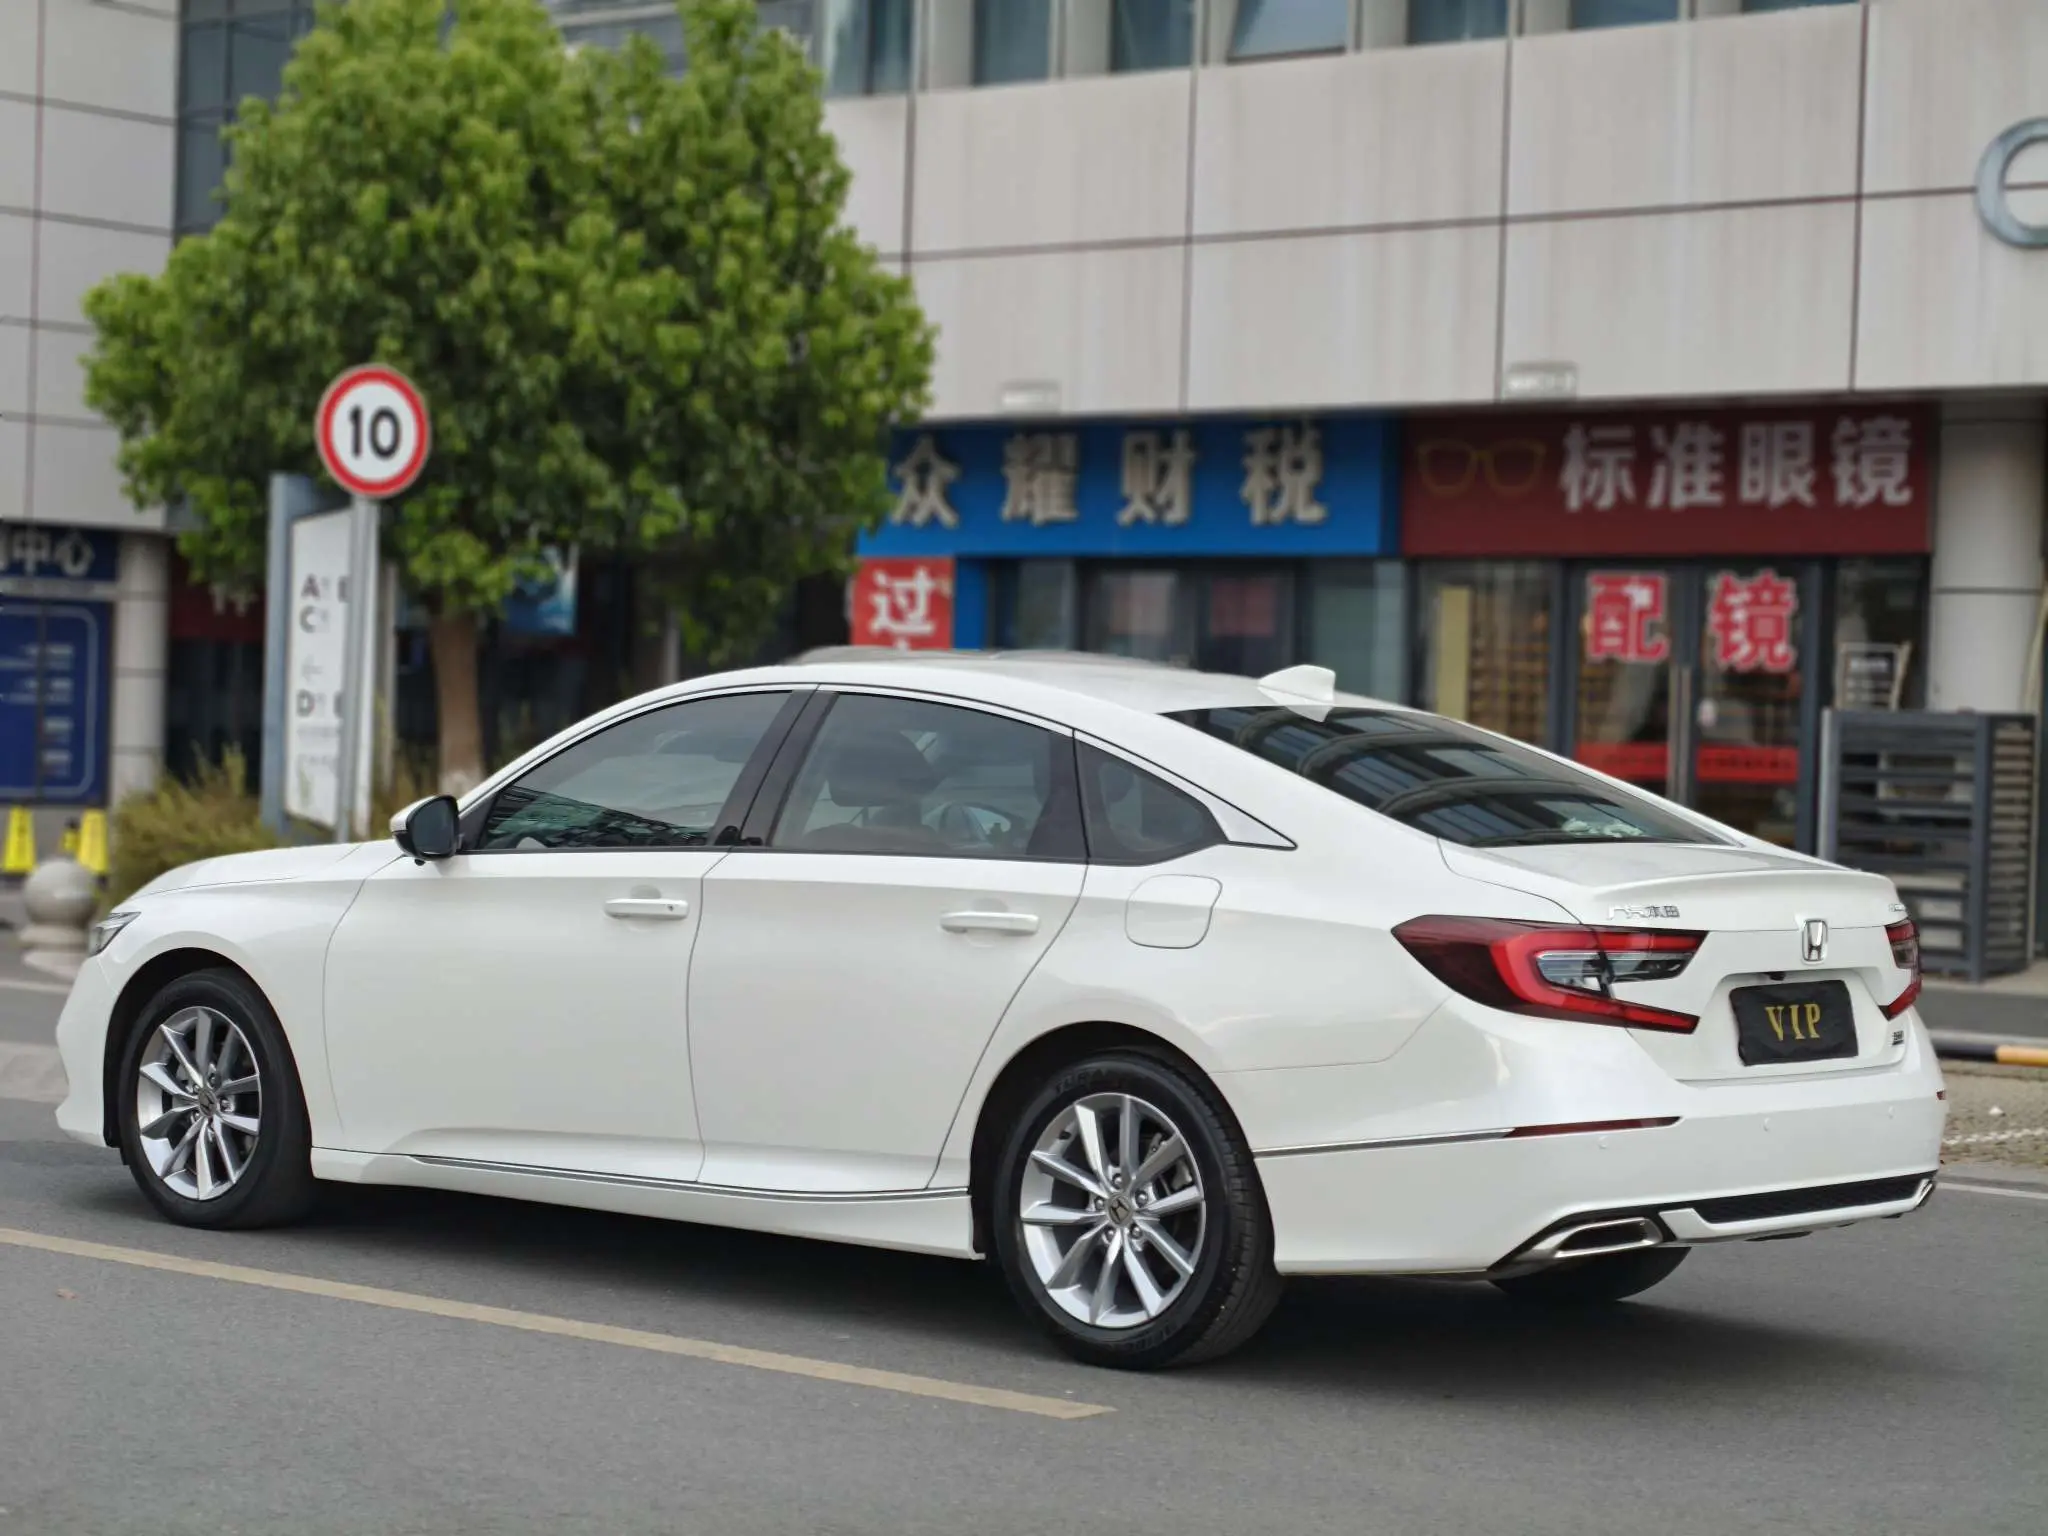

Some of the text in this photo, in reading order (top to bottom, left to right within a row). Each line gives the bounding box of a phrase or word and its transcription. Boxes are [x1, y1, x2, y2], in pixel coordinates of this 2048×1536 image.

[348, 404, 402, 461] 10
[1559, 416, 1913, 513] 标准眼镜
[892, 420, 1328, 528] 众耀财税
[0, 532, 96, 577] 中心
[869, 567, 935, 634] 过
[1586, 570, 1796, 671] 配镜
[1764, 1003, 1821, 1041] VIP
